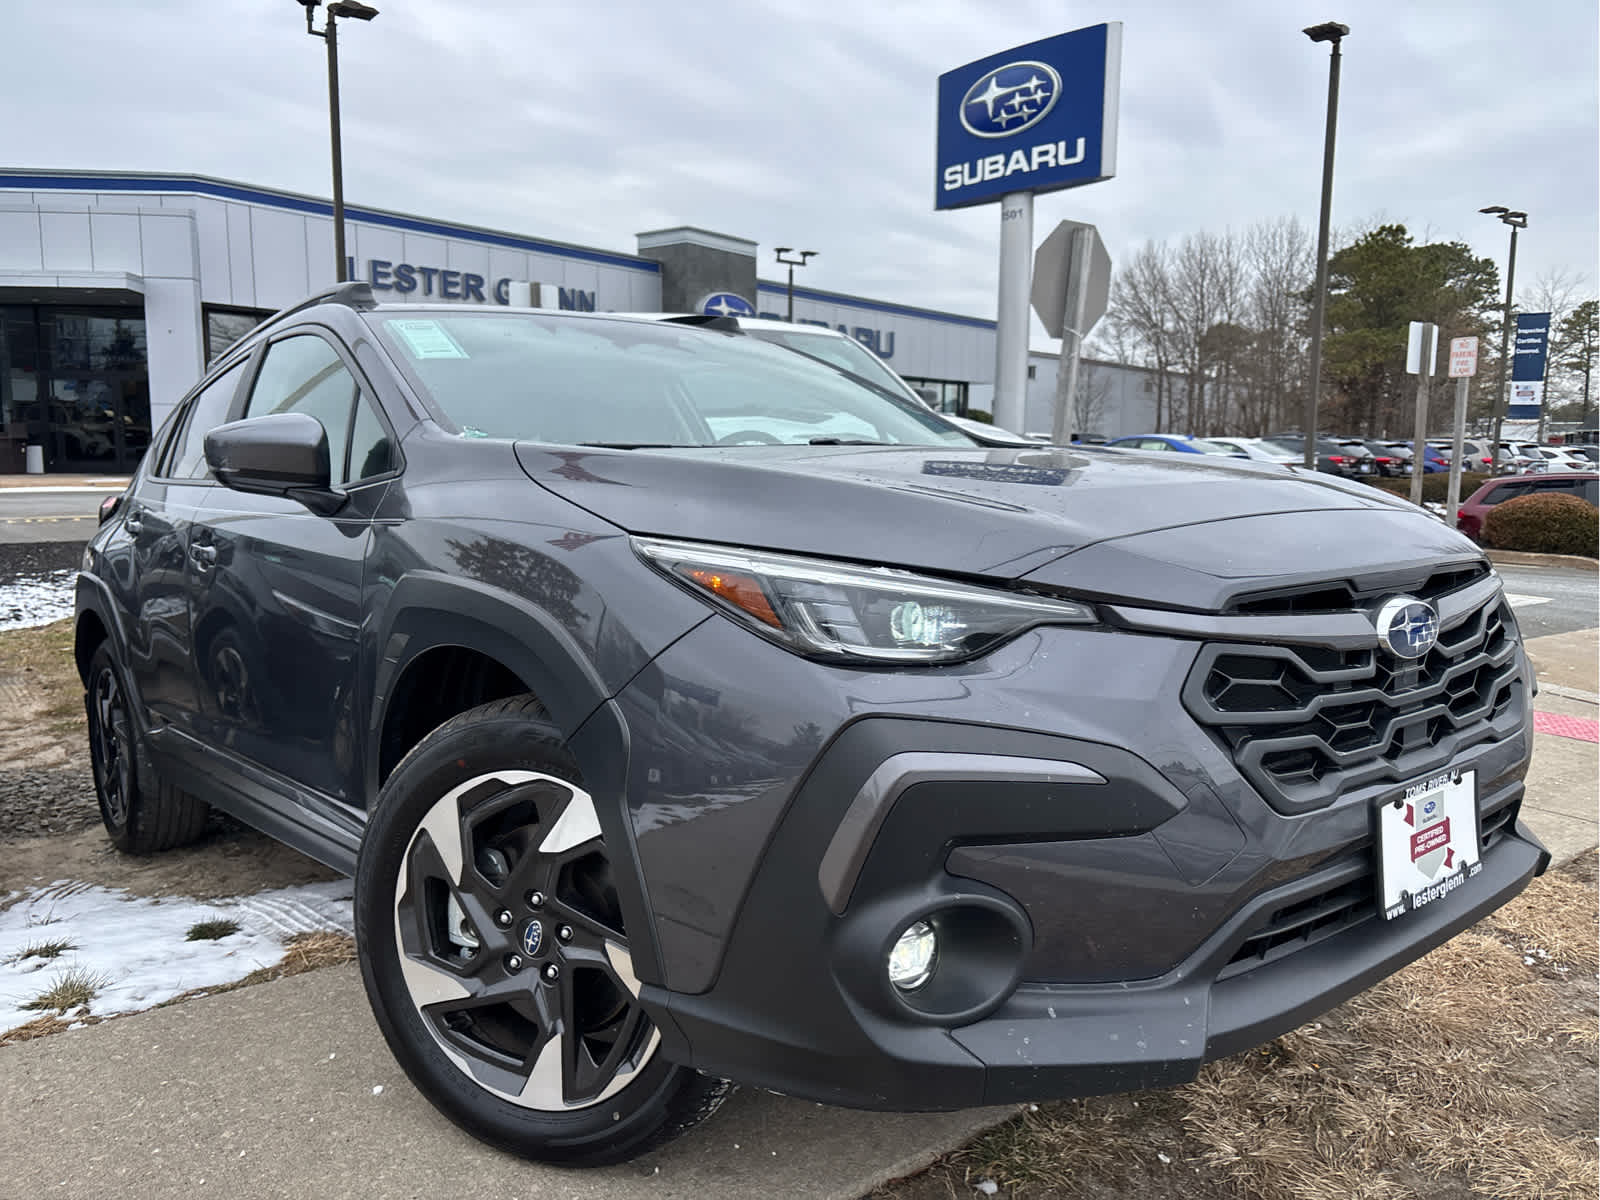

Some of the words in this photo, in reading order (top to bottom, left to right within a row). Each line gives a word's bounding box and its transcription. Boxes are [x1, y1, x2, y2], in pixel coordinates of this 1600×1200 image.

[943, 137, 1086, 191] SUBARU
[347, 257, 487, 302] LESTER
[496, 278, 596, 312] GNN
[1414, 834, 1447, 855] PRE-OWNED
[1417, 826, 1444, 844] CERTIFIED
